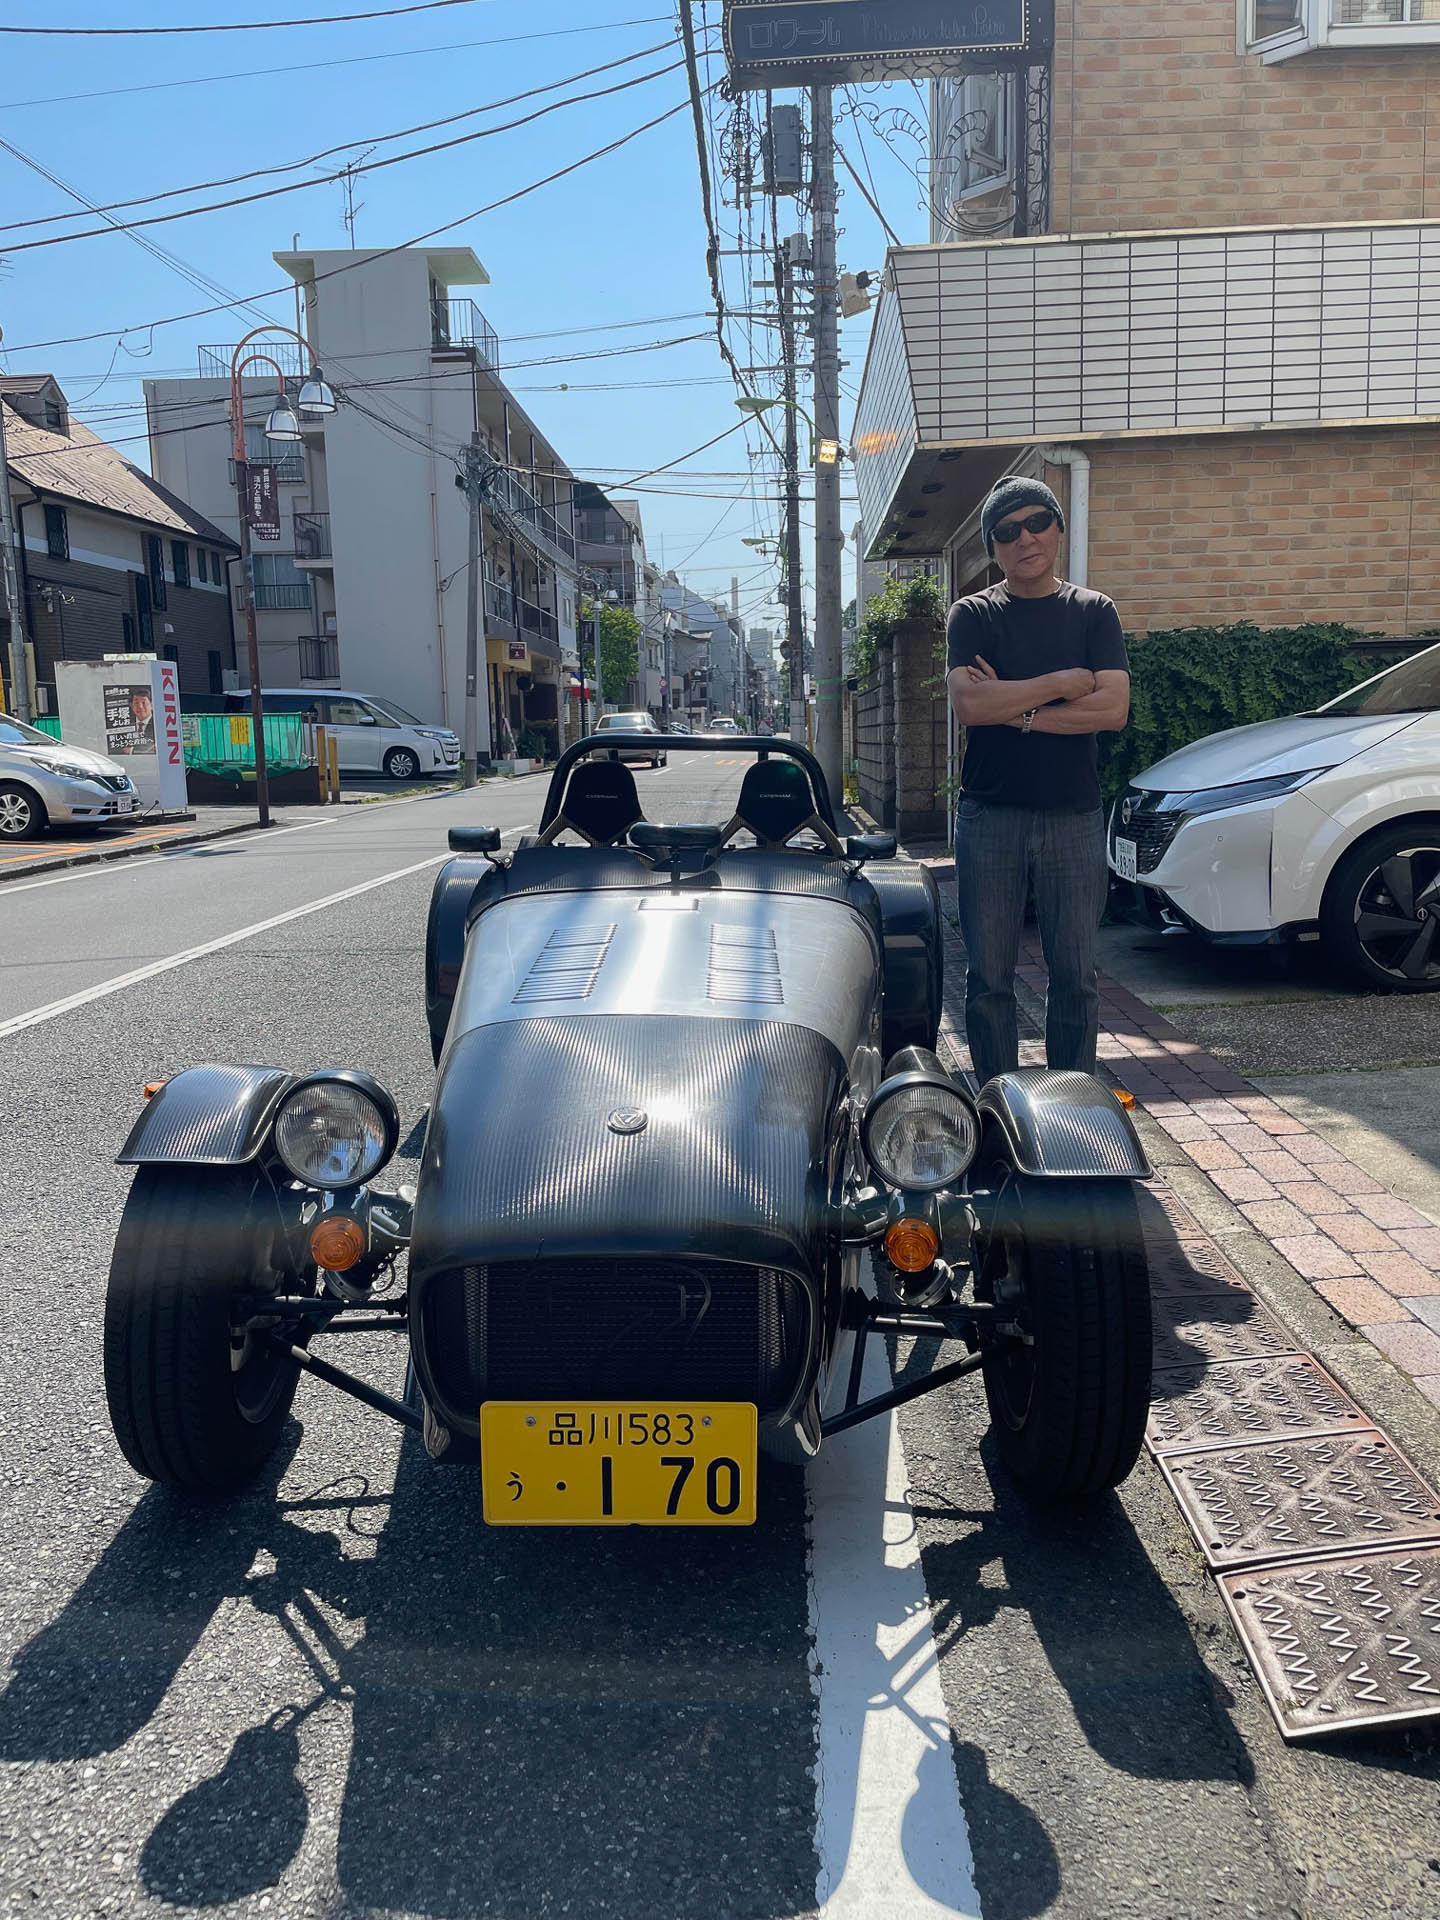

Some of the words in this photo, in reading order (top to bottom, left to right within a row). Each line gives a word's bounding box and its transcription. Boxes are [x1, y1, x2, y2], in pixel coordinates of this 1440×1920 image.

[748, 17, 841, 49] ロワール
[107, 706, 130, 721] 手塚
[161, 667, 180, 764] KIRIN
[549, 1413, 694, 1445] 品川583
